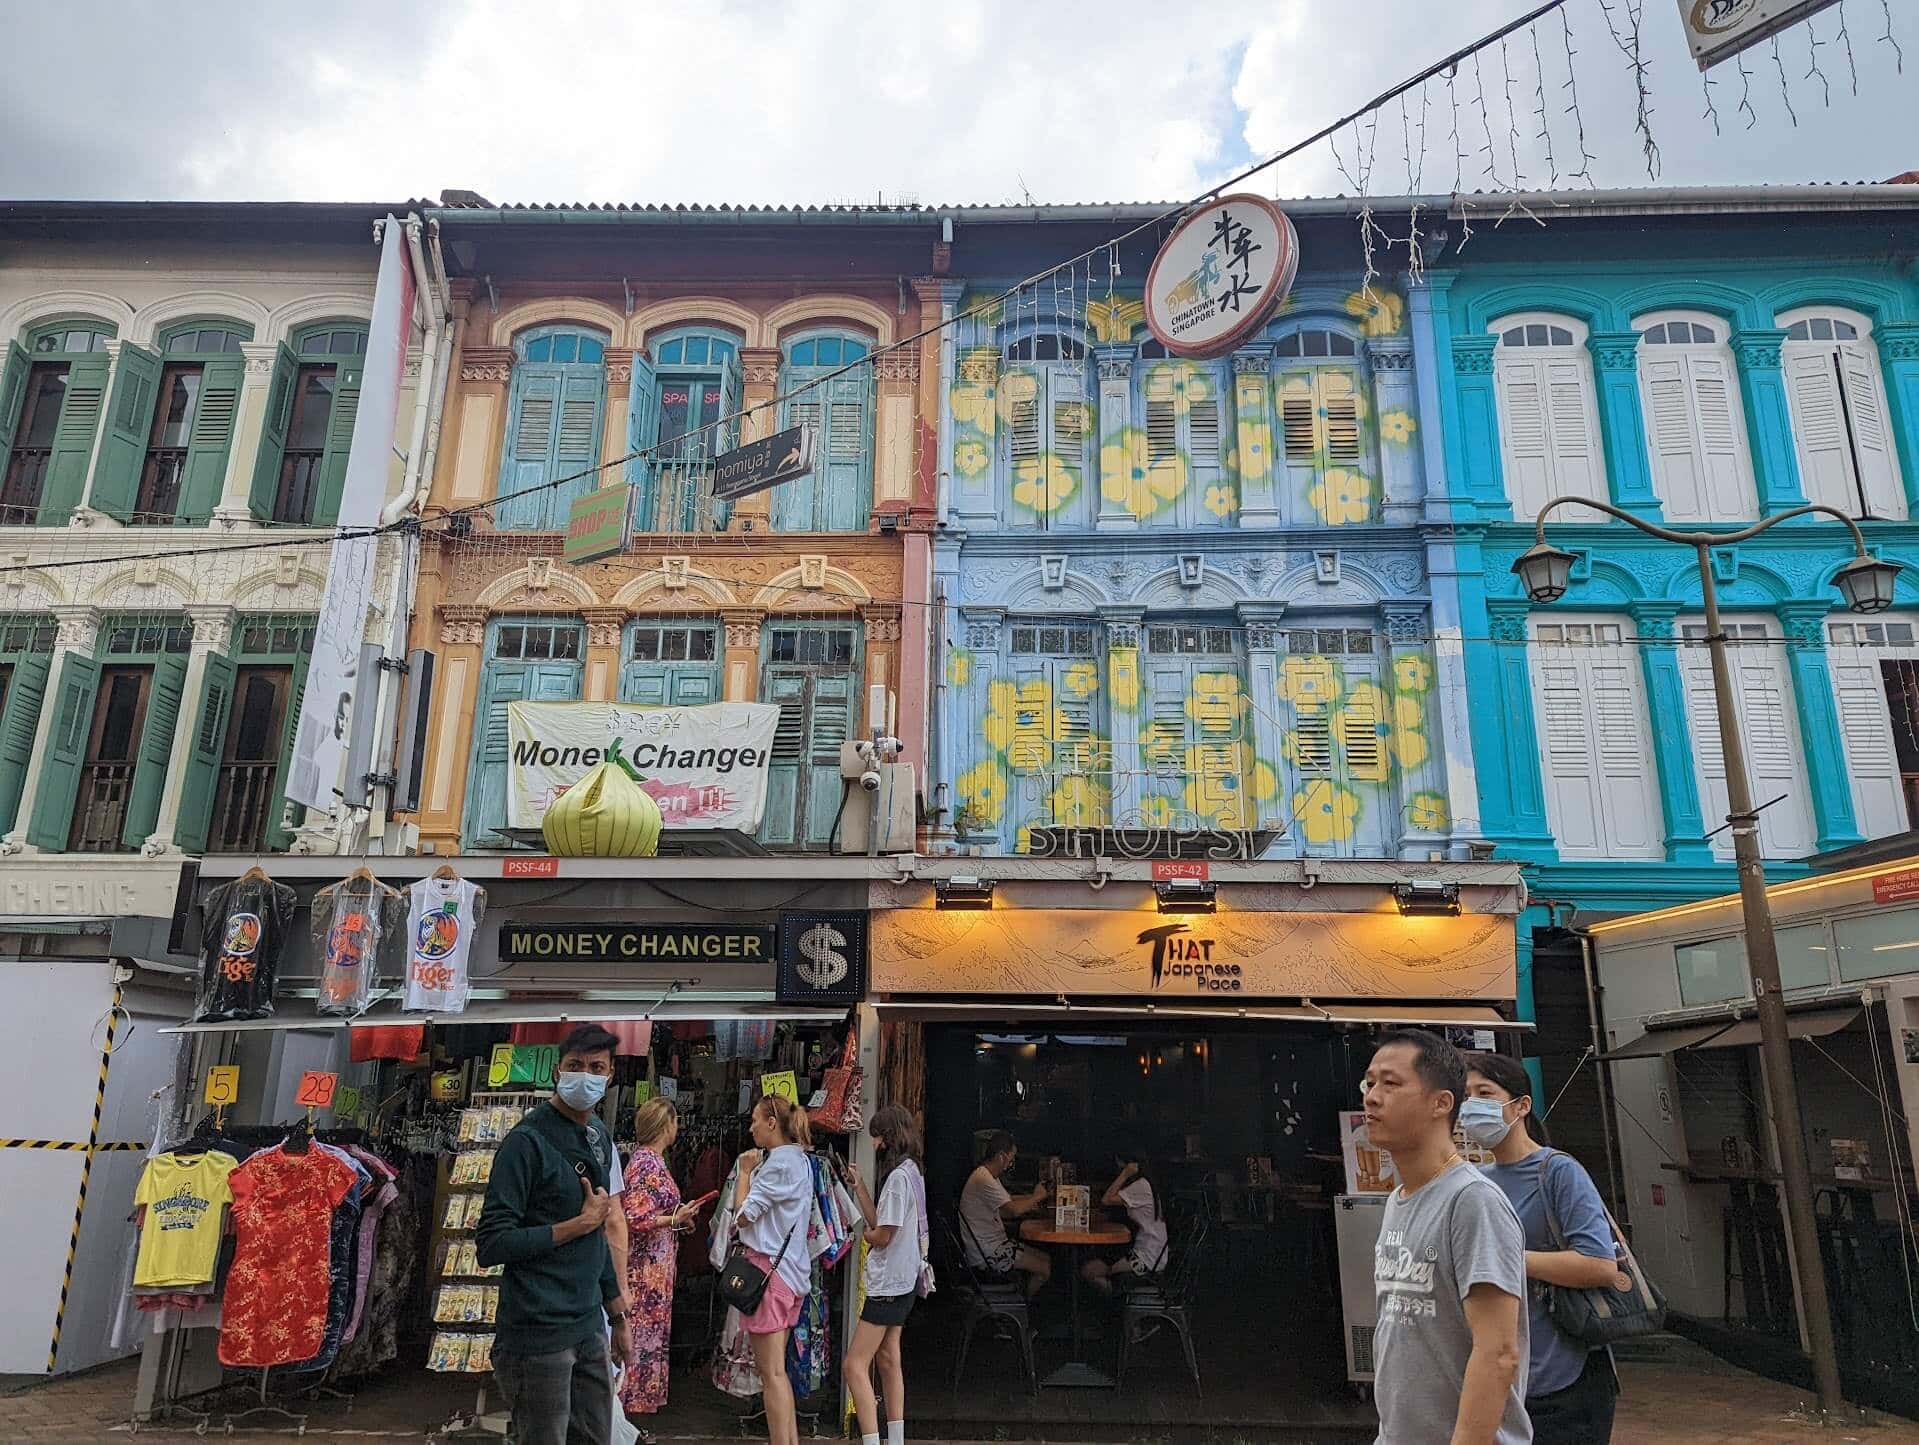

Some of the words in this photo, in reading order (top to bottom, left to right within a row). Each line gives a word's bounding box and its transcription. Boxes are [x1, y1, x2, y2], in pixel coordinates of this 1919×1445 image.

[1171, 297, 1215, 326] CHINATOWN
[1172, 308, 1216, 336] SINGAPORE
[663, 392, 688, 404] SPA
[704, 392, 720, 404] SP
[717, 452, 763, 482] nomiya
[1025, 807, 1241, 859] SHOPS
[509, 861, 552, 873] PSSF-44
[1158, 864, 1202, 876] PSSF-42
[1876, 883, 1906, 893] EMERGENCY
[511, 933, 612, 956] MONEY
[619, 934, 761, 957] CHANGER
[797, 923, 848, 990] $
[1136, 924, 1215, 988] THAT
[411, 961, 455, 991] Tiger
[1163, 960, 1241, 978] Japanese
[1197, 976, 1241, 991] Place
[1755, 978, 1764, 996] 8
